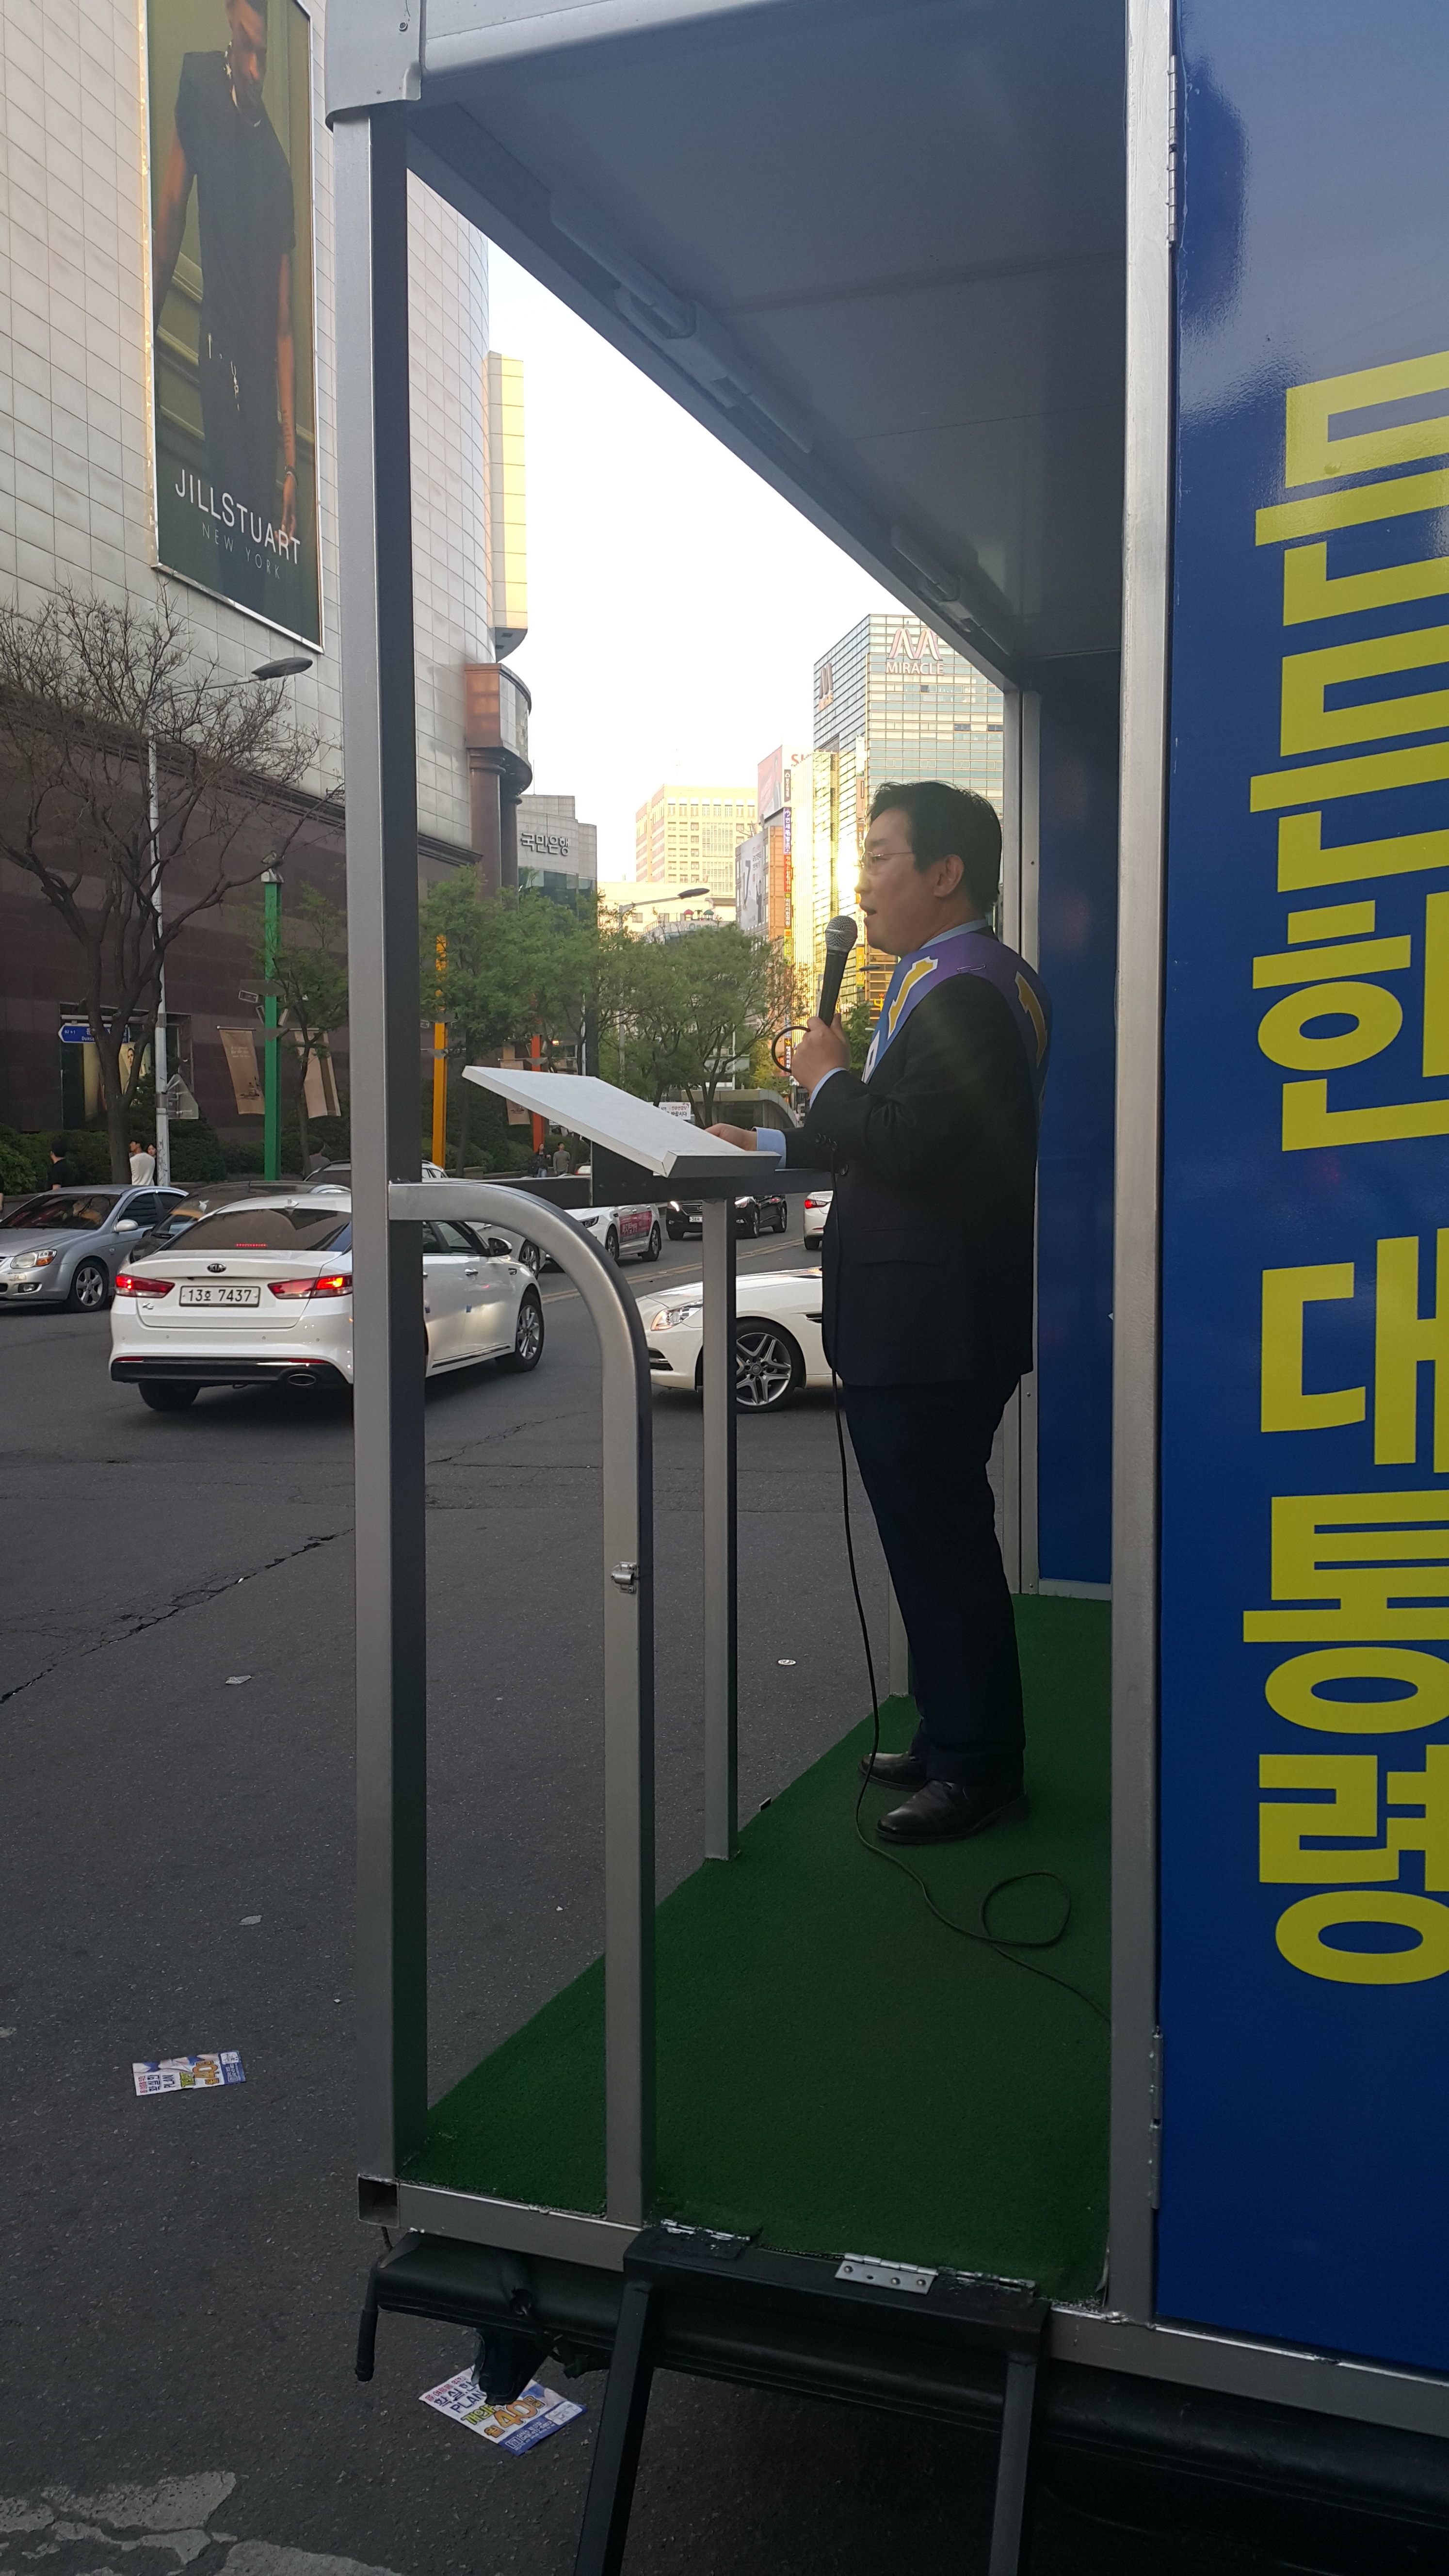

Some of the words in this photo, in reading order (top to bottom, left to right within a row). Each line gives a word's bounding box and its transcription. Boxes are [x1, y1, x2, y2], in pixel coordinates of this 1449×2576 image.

[175, 468, 301, 564] JILLSTUART
[202, 522, 234, 552] NEW
[245, 547, 280, 579] YORK
[886, 661, 945, 676] MIRACLE
[1250, 350, 1449, 1152] 든든한
[521, 833, 571, 856] 국민은행
[188, 1289, 211, 1302] 13호
[218, 1289, 252, 1302] 7437
[1242, 1227, 1449, 1985] 대통령
[450, 2390, 487, 2414] PLAN
